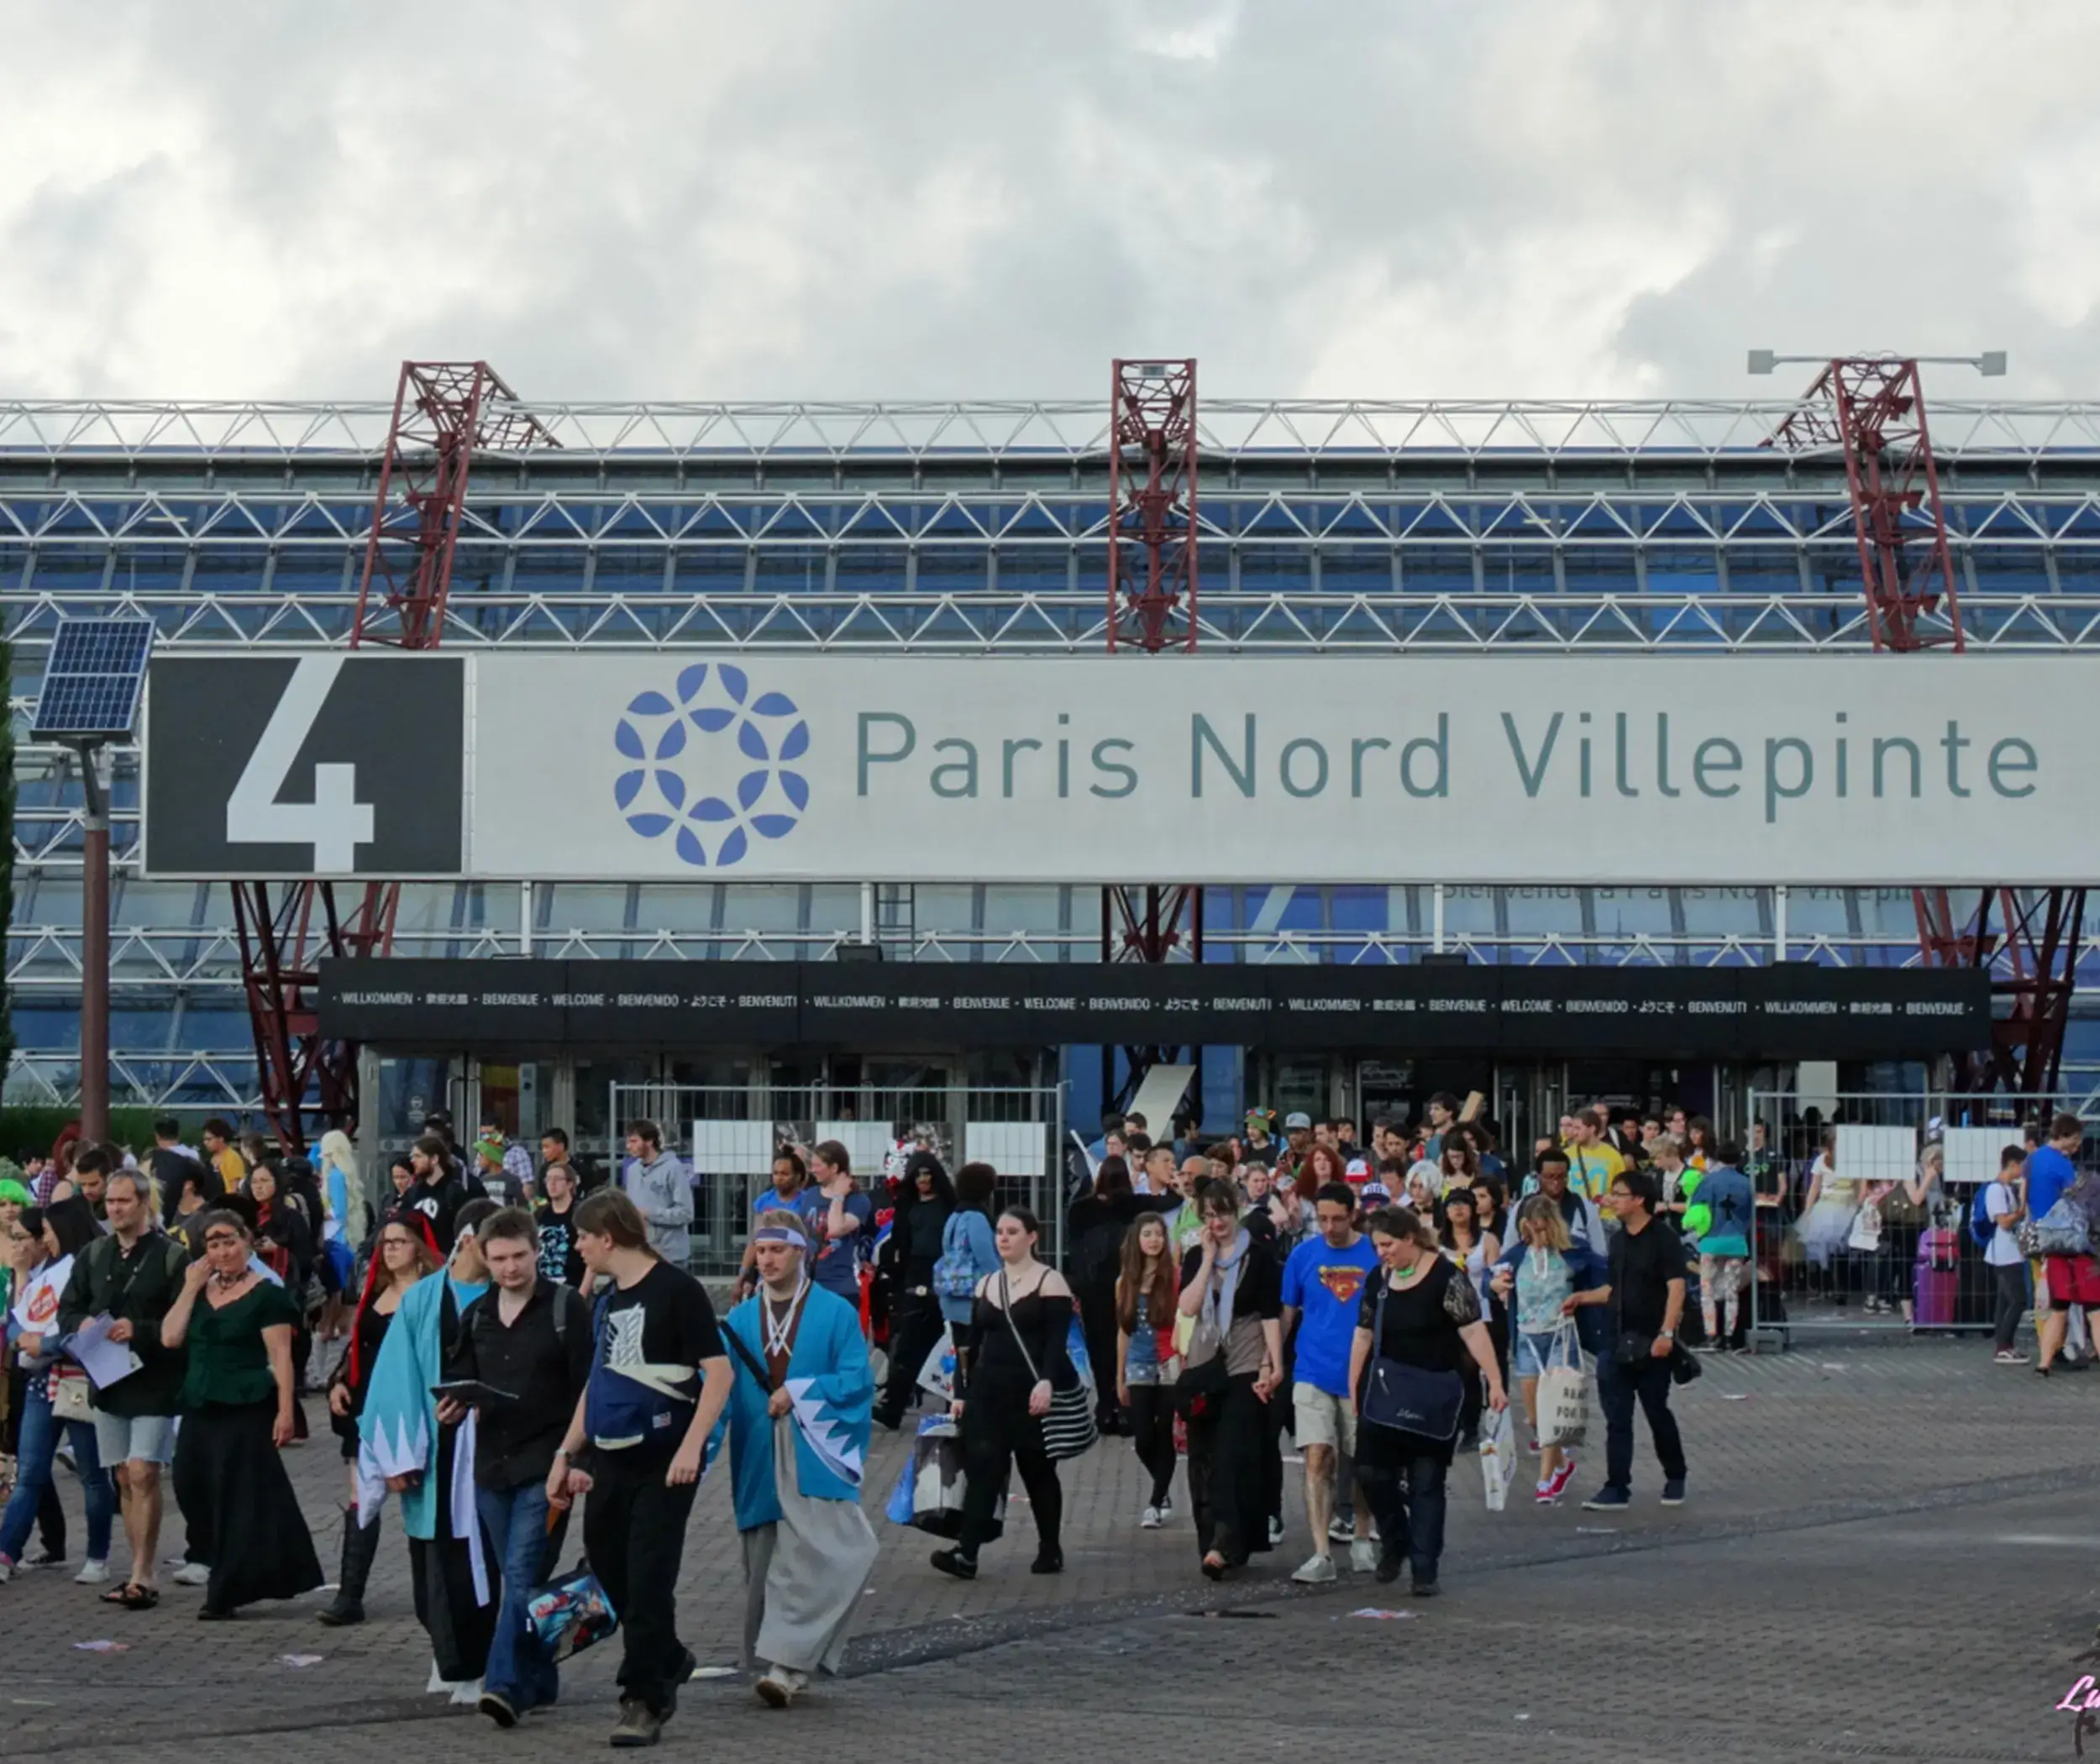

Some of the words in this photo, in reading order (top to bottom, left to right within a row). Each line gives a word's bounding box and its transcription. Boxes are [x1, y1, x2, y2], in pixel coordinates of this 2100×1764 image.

[226, 656, 375, 873] 4
[857, 711, 1138, 799] Paris
[1191, 711, 1449, 799] Nord
[1500, 711, 2039, 824] Villepinte
[340, 991, 414, 1005] WILLKOMMEN
[481, 993, 539, 1006] BIENVENUE
[551, 994, 605, 1007] WELCOME
[738, 995, 798, 1008] BENVENUTI
[813, 995, 886, 1009] WILLKOMMEN
[953, 997, 1011, 1010] BIENVENUE
[1023, 997, 1076, 1011] WELCOME
[1212, 998, 1273, 1011] BENVENUTI
[1288, 998, 1362, 1011] WILLKOMMEN
[1429, 999, 1487, 1013] BIENVENUE
[1500, 1000, 1553, 1013] WELCOME
[1688, 1000, 1747, 1014] BENVENUTI
[1764, 1000, 1838, 1015] WILLKOMMEN
[1905, 1001, 1965, 1016] BIENVENUE
